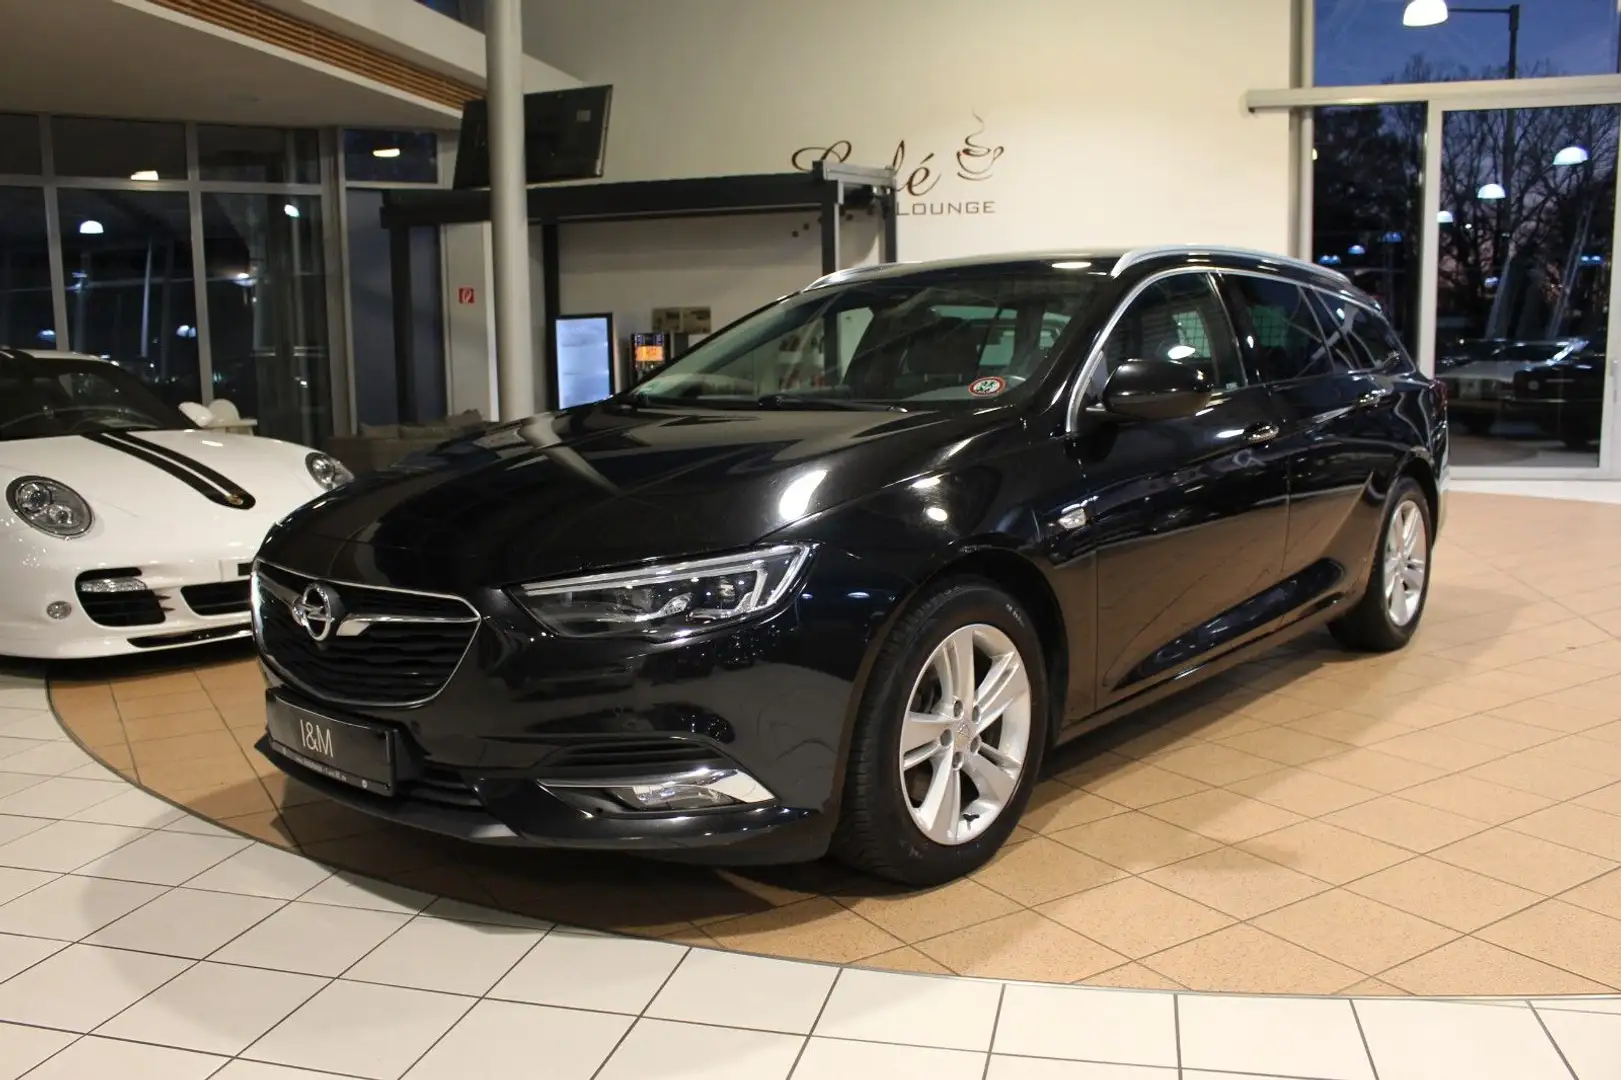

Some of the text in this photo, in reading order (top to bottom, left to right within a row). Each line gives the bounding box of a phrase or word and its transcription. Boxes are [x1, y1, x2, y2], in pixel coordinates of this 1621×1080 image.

[791, 139, 942, 197] Cé
[896, 201, 996, 216] LOUNGE
[300, 719, 334, 758] I&M
